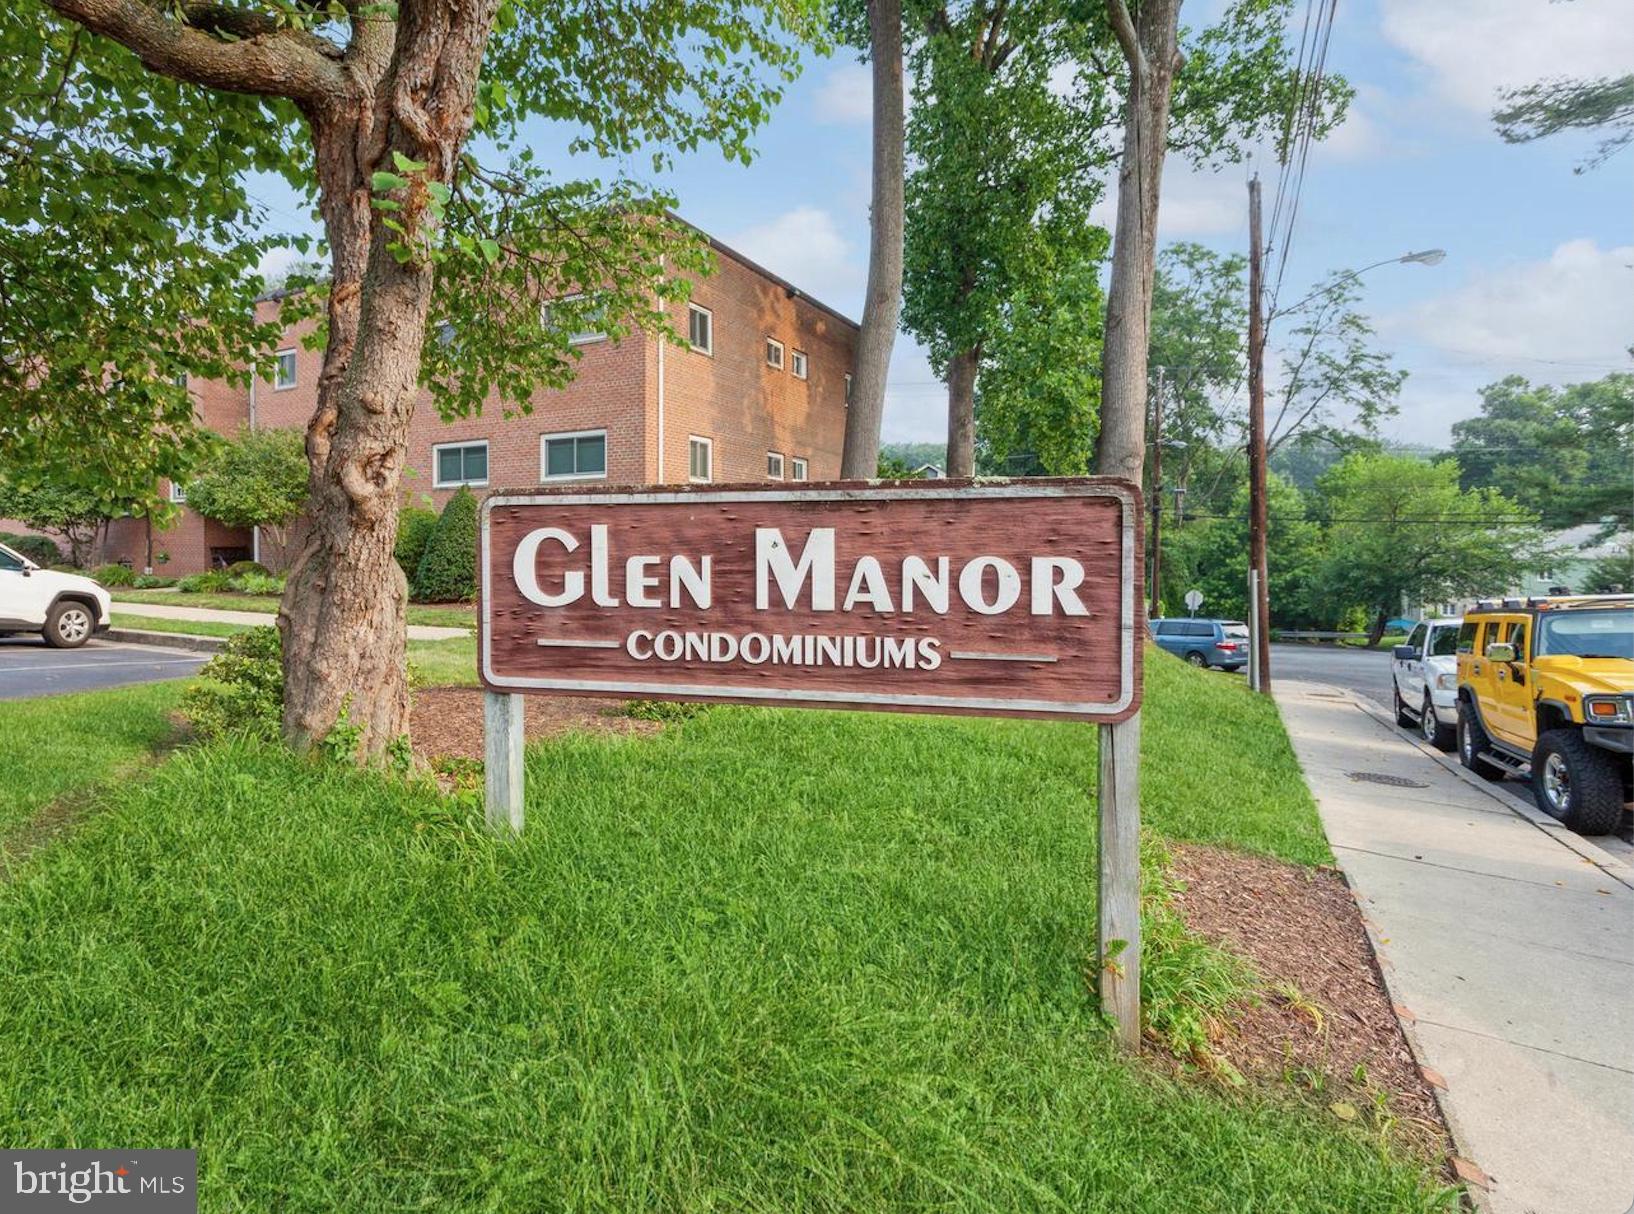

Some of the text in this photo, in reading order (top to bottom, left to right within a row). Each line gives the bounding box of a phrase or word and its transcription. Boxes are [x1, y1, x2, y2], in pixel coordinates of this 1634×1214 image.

[513, 524, 1091, 616] GLEN MANOR
[626, 629, 942, 671] CONDOMINIUMS
